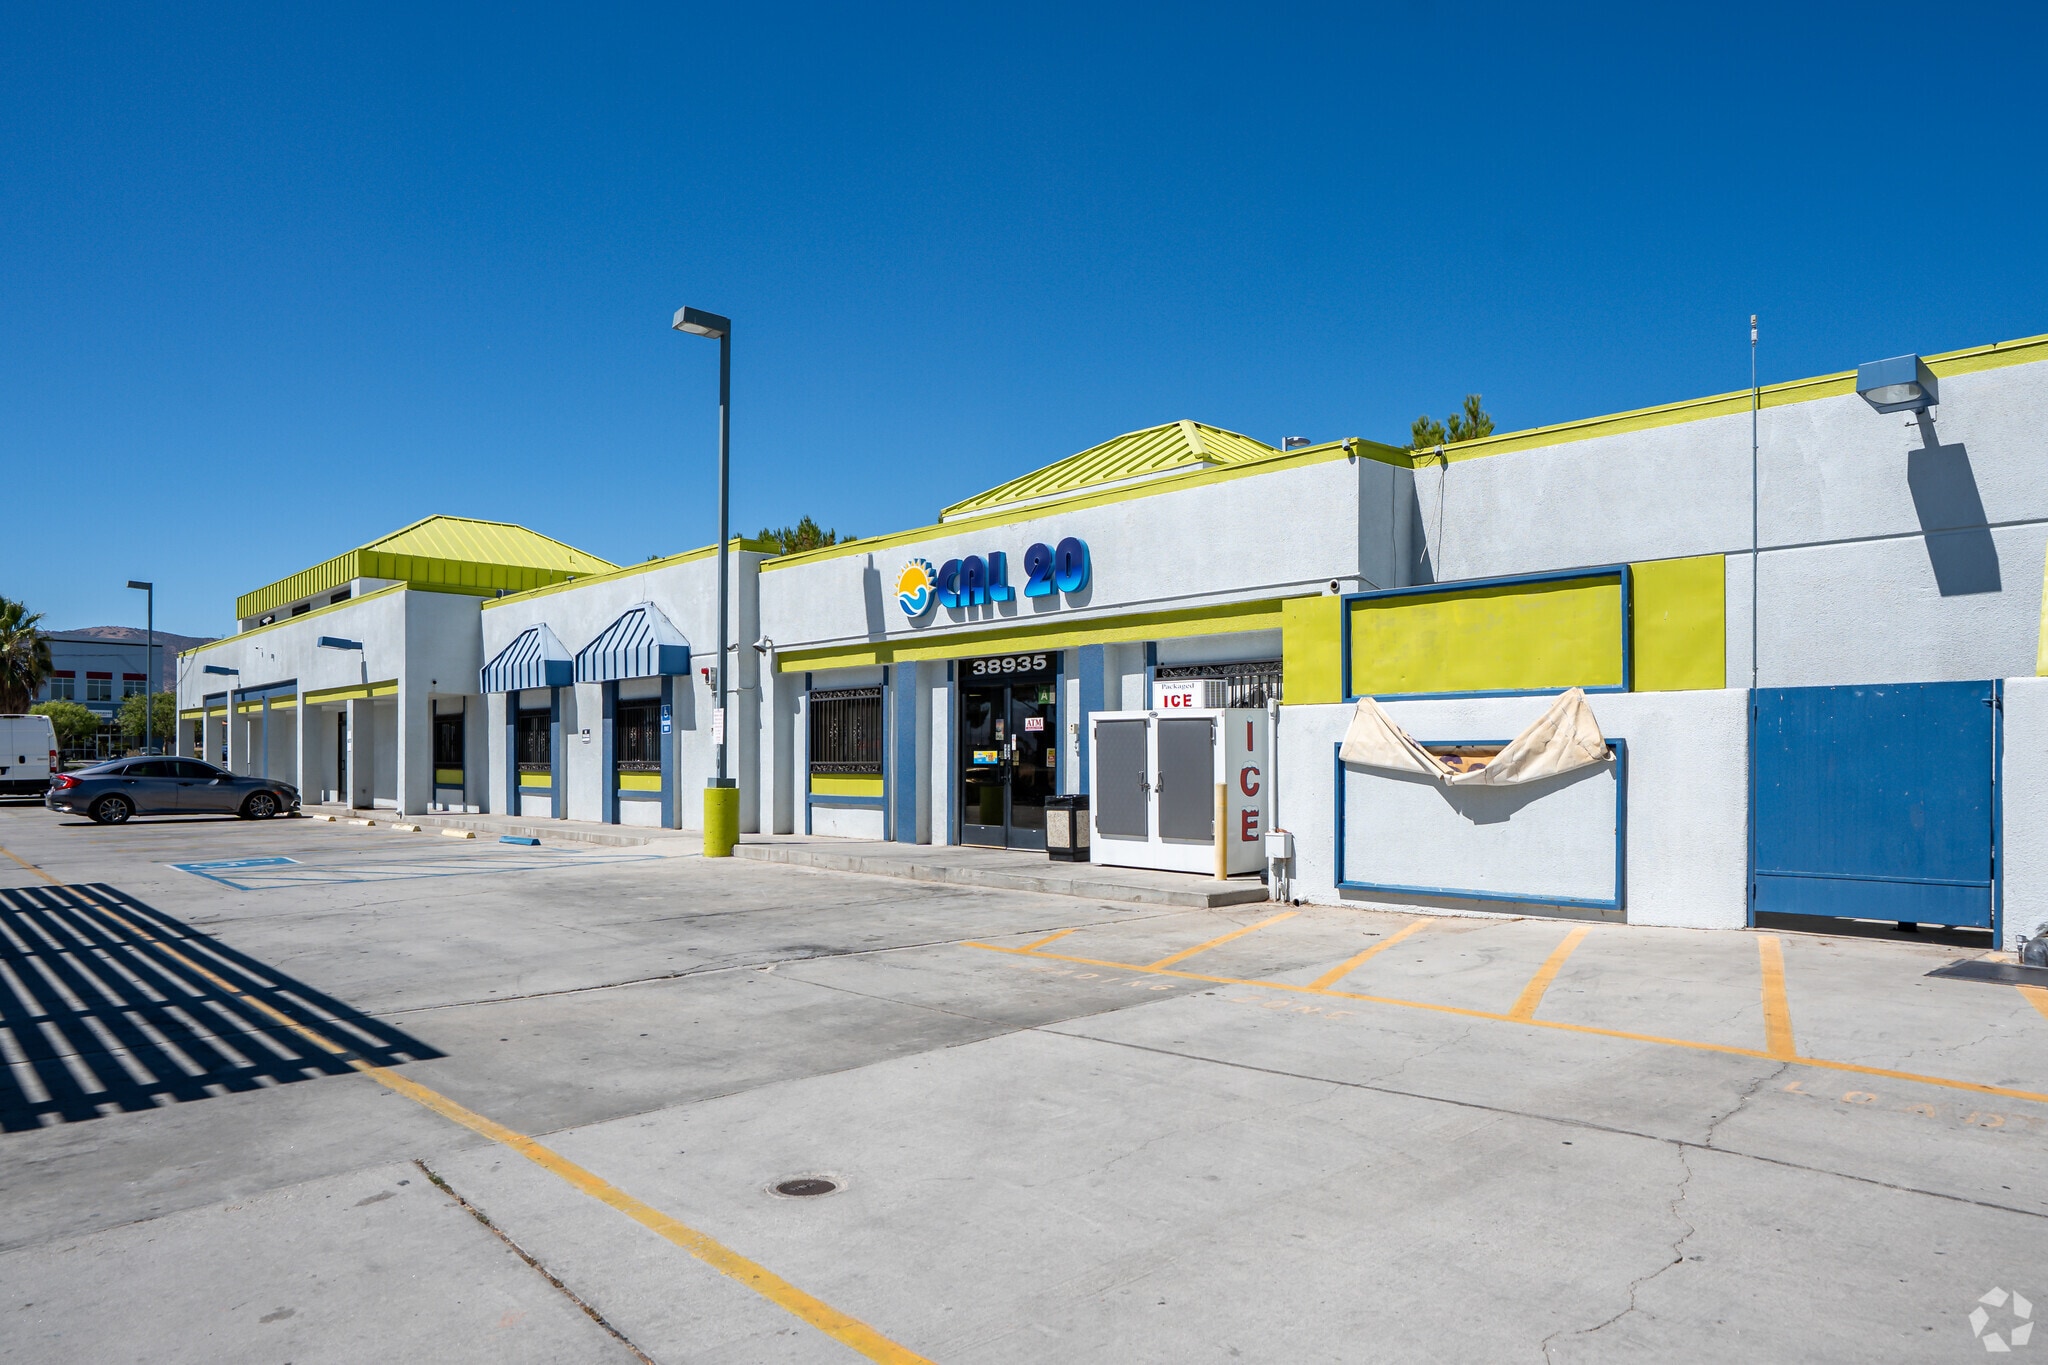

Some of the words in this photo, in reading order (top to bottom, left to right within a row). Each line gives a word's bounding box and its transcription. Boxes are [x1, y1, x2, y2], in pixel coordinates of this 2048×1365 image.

[937, 550, 1015, 608] CAL
[1024, 536, 1090, 598] 20
[972, 655, 1047, 675] 38935
[1041, 691, 1048, 701] A
[1163, 693, 1193, 708] ICE
[1026, 718, 1042, 726] ATM
[1240, 715, 1261, 843] ICE
